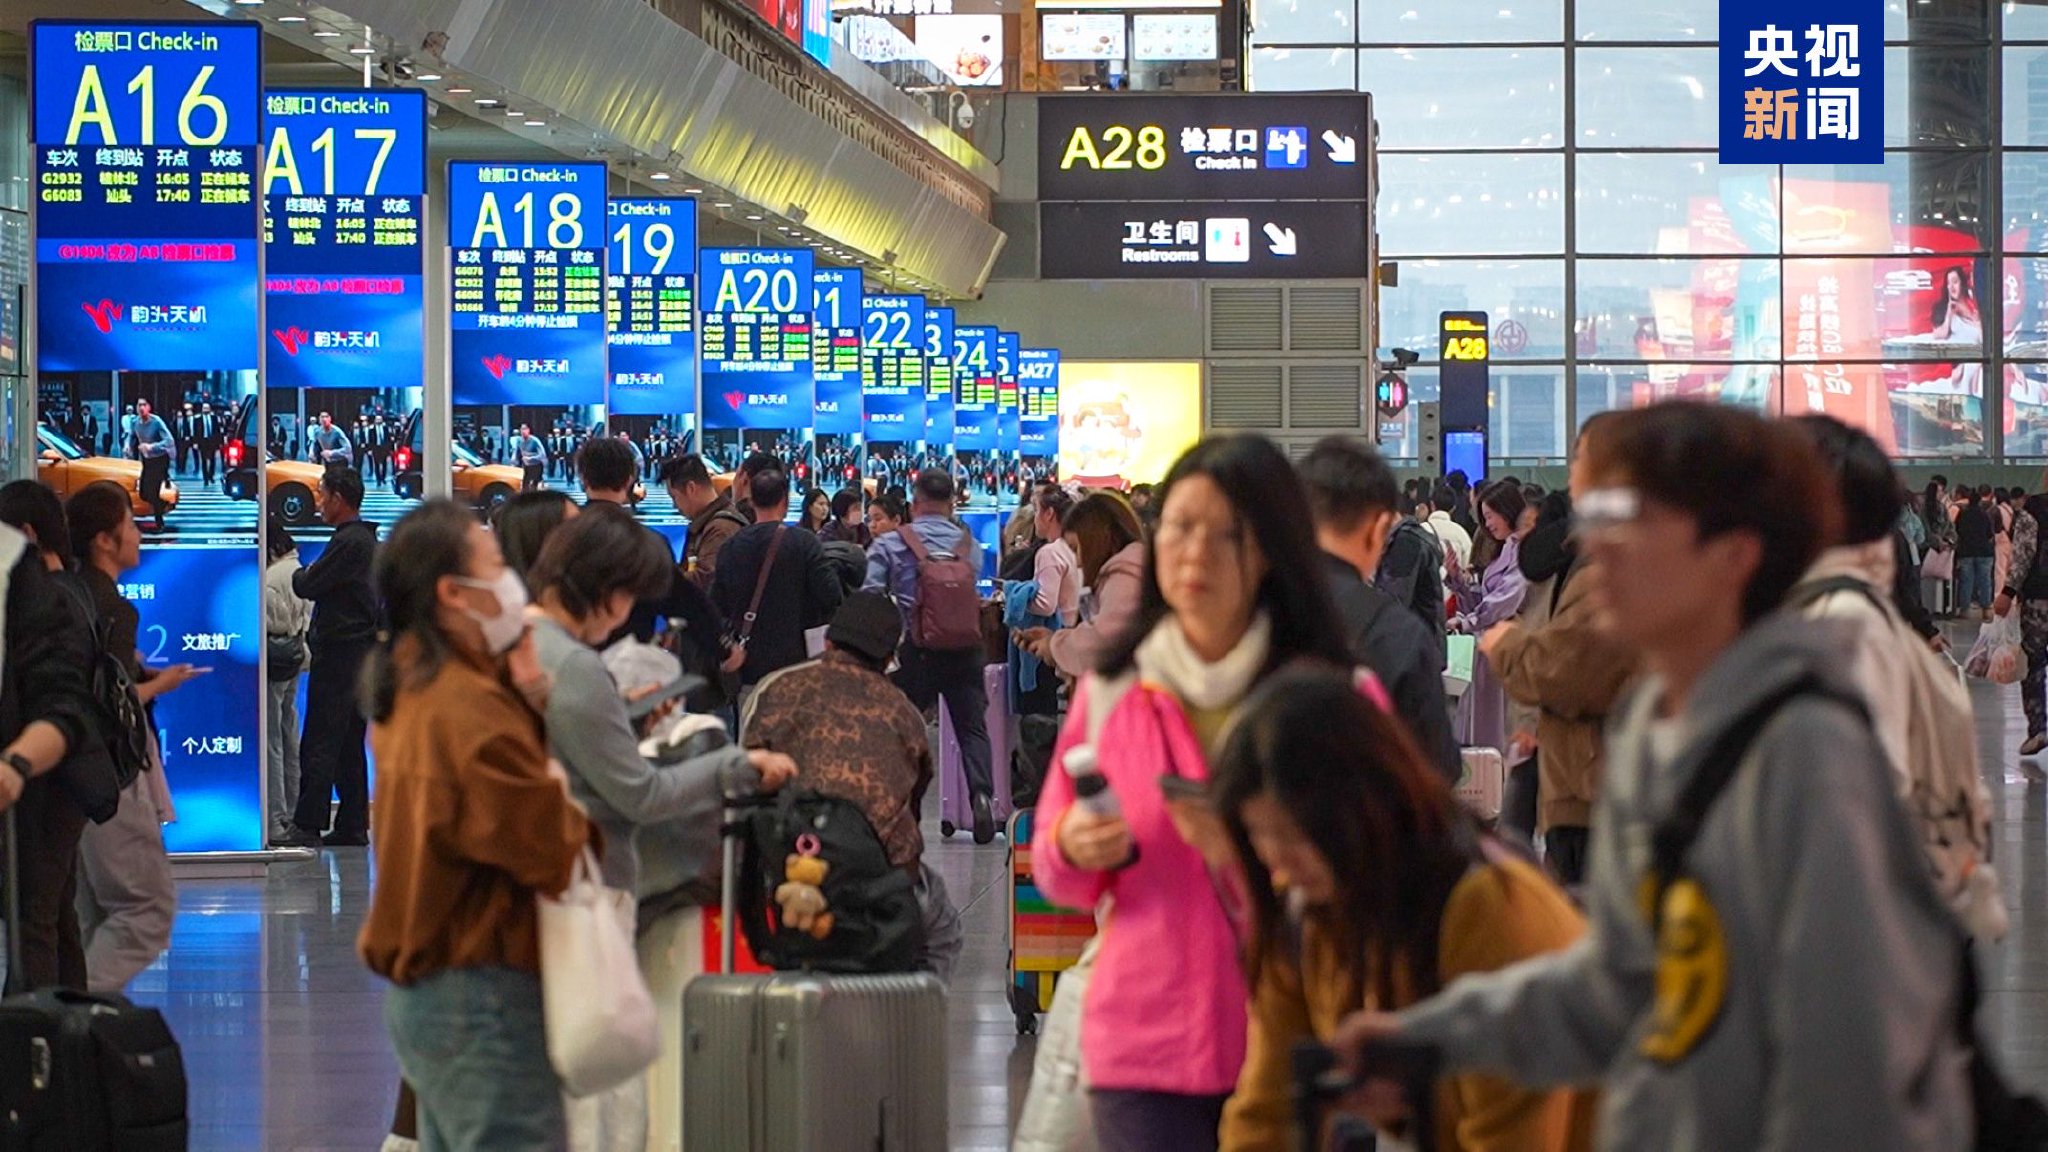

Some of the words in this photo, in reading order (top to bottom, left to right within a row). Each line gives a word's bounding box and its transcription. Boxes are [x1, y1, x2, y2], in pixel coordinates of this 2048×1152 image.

[75, 31, 131, 52] 检票口
[138, 32, 217, 50] Check-in
[65, 65, 227, 145] A16
[267, 96, 315, 115] 检票口
[321, 96, 389, 113] Check-in
[47, 149, 78, 166] 车次
[96, 148, 143, 166] 终到站
[157, 149, 188, 166] 开点
[210, 149, 242, 166] 状态
[1061, 126, 1165, 169] A28
[1181, 127, 1257, 153] 检票口
[265, 127, 396, 195] A17
[479, 167, 518, 182] 检票口
[522, 168, 577, 181] Check-in
[157, 189, 190, 201] 17:40
[337, 198, 364, 213] 开点
[382, 199, 410, 213] 状态
[471, 192, 582, 248] A18
[621, 203, 670, 215] Check-in
[1122, 220, 1198, 244] 卫生间
[614, 224, 674, 274] 19
[1122, 248, 1199, 262] Restrooms
[715, 269, 797, 312] A20
[863, 312, 911, 348] 22
[953, 341, 988, 372] 24
[1444, 337, 1486, 359] A28
[147, 624, 168, 662] 2
[182, 633, 240, 650] 文旅推广
[183, 736, 241, 754] 个人定制
